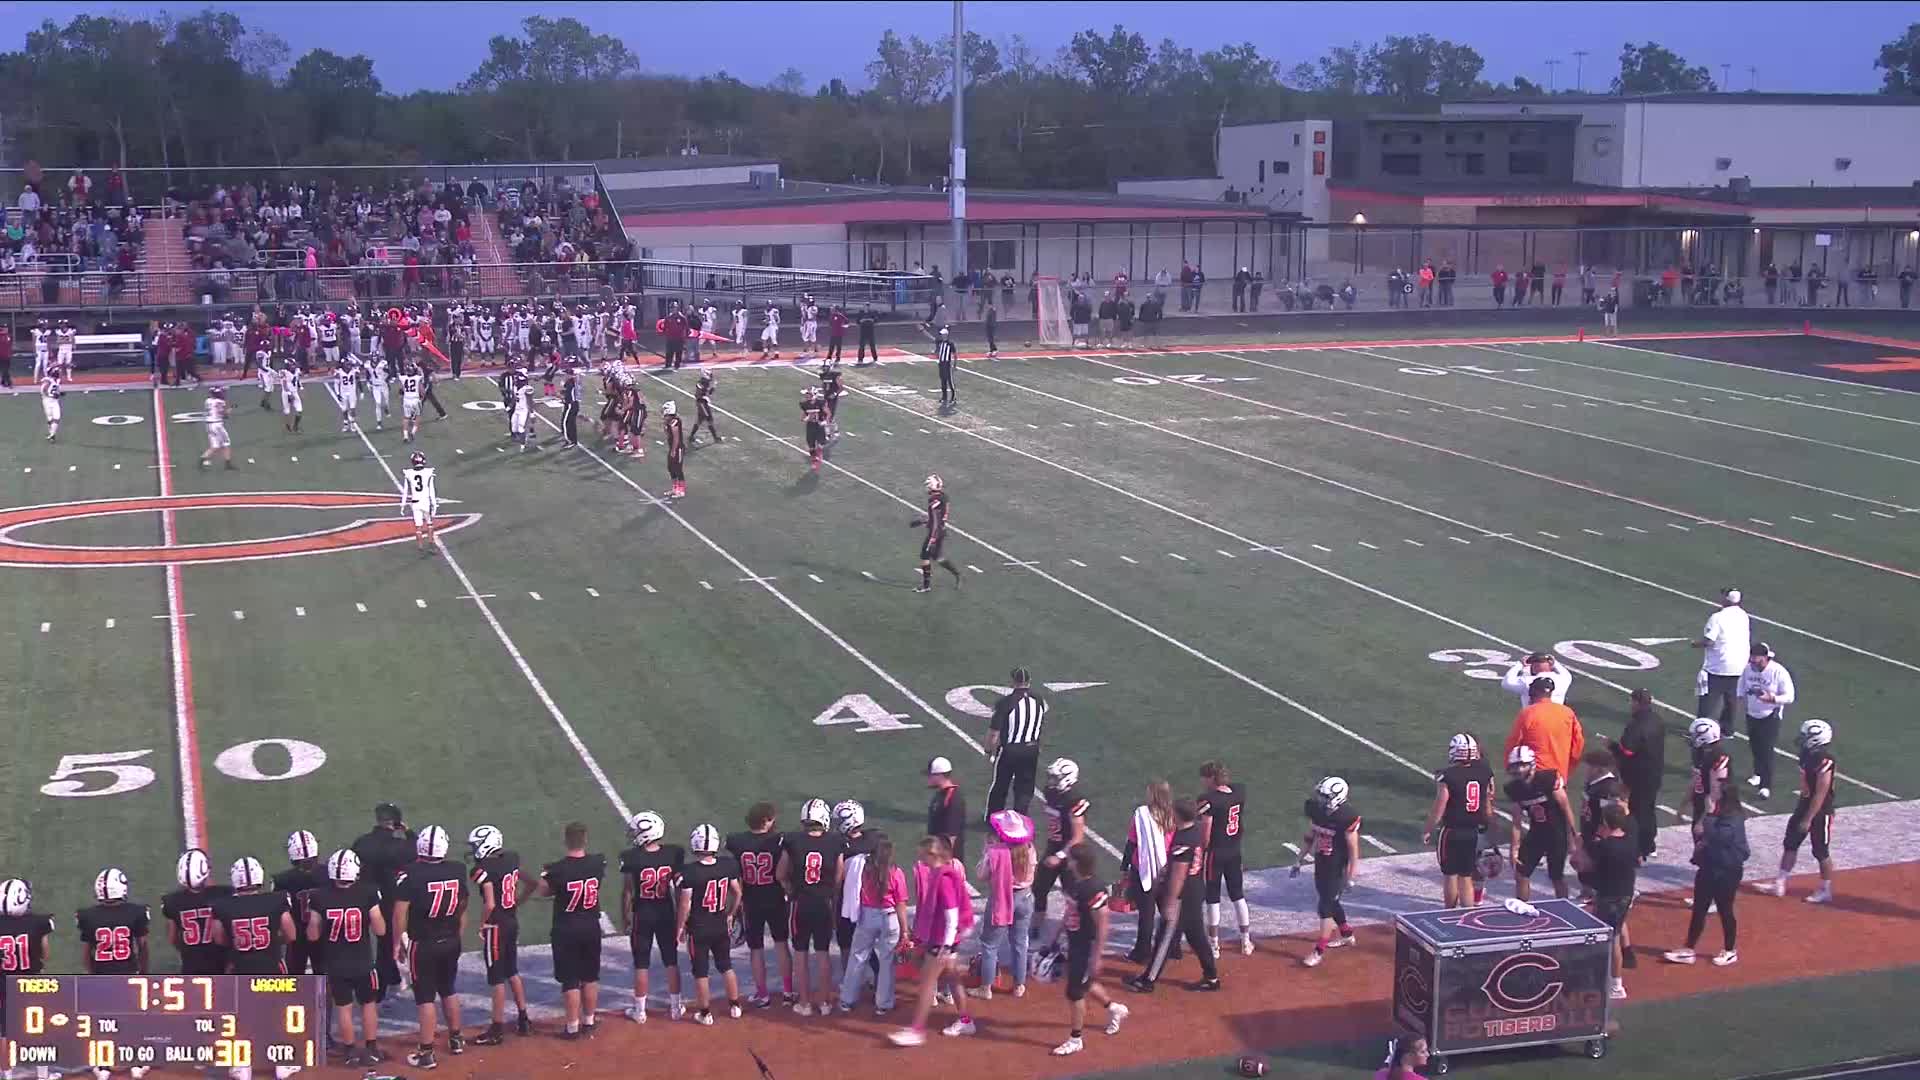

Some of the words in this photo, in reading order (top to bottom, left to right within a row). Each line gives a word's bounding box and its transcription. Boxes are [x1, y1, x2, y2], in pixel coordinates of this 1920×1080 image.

[403, 379, 416, 393] 42
[414, 474, 424, 492] 3
[1466, 781, 1480, 812] 9
[1226, 804, 1240, 836] 5
[741, 852, 774, 885] 62
[805, 852, 822, 884] 8
[427, 879, 459, 918] 77
[566, 877, 599, 912] 76
[702, 877, 728, 912] 41
[180, 907, 212, 945] 57
[232, 917, 271, 951] 55
[326, 908, 362, 942] 70
[0, 934, 30, 971] 31
[95, 926, 131, 961] 26
[1481, 952, 1563, 1012] C
[1484, 1015, 1557, 1037] TIGERS
